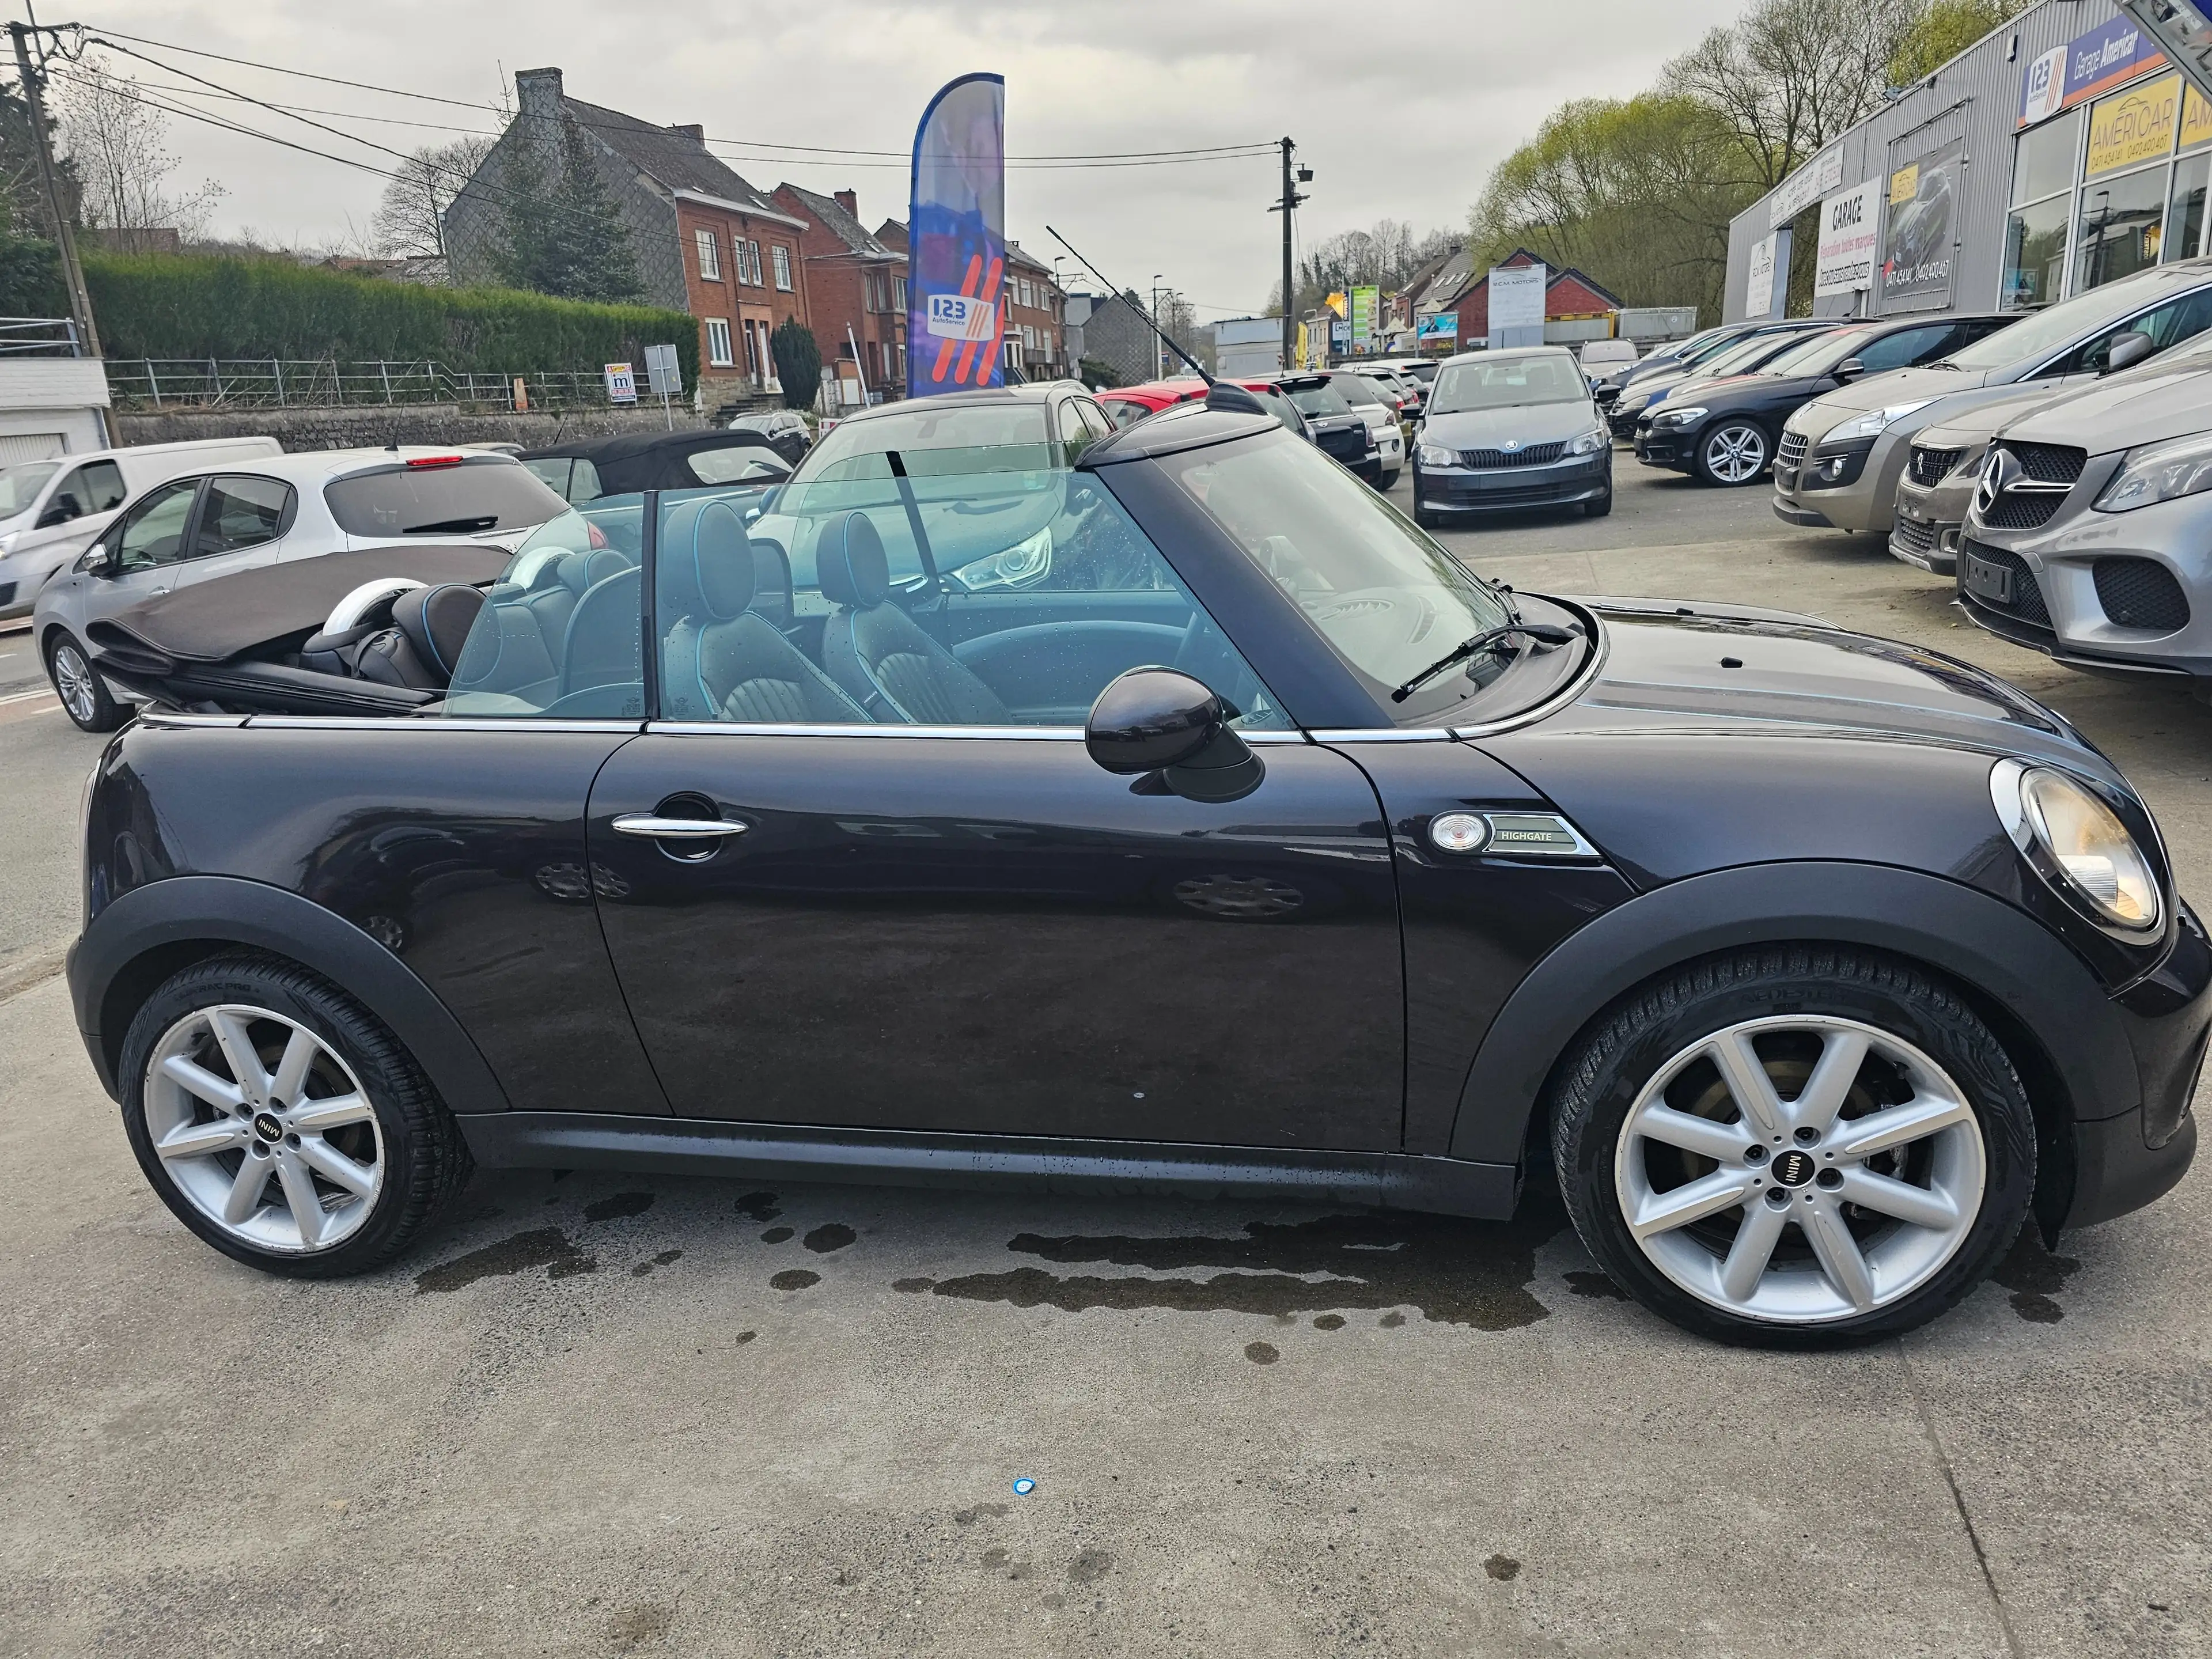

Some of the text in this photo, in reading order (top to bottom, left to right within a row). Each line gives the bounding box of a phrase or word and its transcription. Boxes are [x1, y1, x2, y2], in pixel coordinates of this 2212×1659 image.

[2074, 28, 2139, 80] Garage Americar
[2091, 98, 2173, 153] AMERICAR
[1833, 195, 1862, 232] GARAGE
[1854, 232, 1876, 253] marques
[933, 317, 965, 326] AutoService
[1502, 831, 1552, 841] HIGHGATE
[259, 1119, 280, 1137] MINI
[1785, 1155, 1802, 1182] MINI
